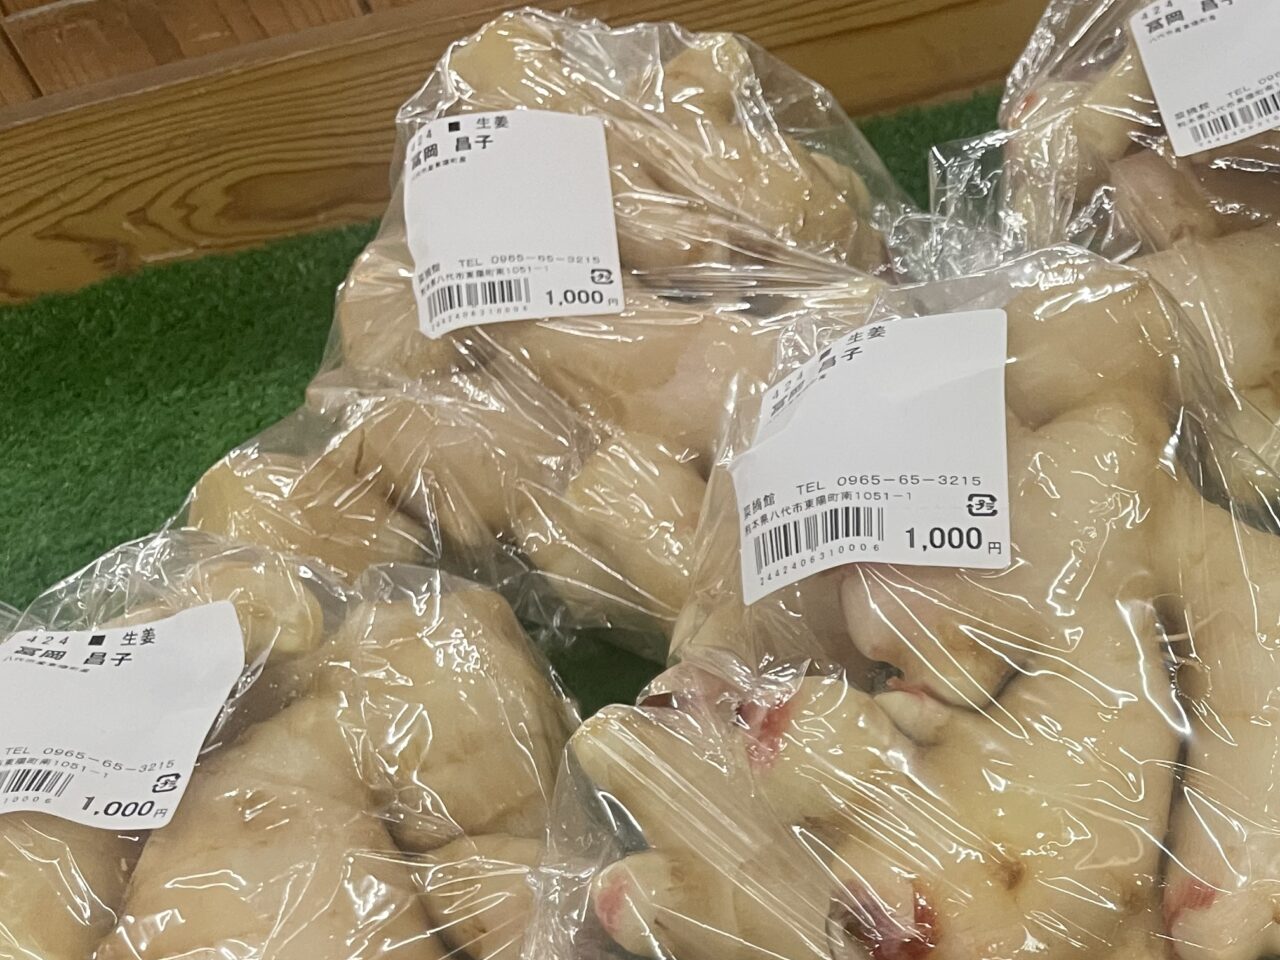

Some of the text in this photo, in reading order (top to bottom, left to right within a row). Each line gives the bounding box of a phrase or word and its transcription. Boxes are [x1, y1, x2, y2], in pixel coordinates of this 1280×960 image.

[1227, 84, 1251, 99] TEL
[458, 258, 483, 267] TEL
[846, 325, 887, 346] 生姜
[795, 481, 826, 496] TEL
[836, 474, 982, 487] 0965-65-3215
[119, 627, 157, 647] 生姜
[5, 746, 176, 773] TEL 0965-65-3215
